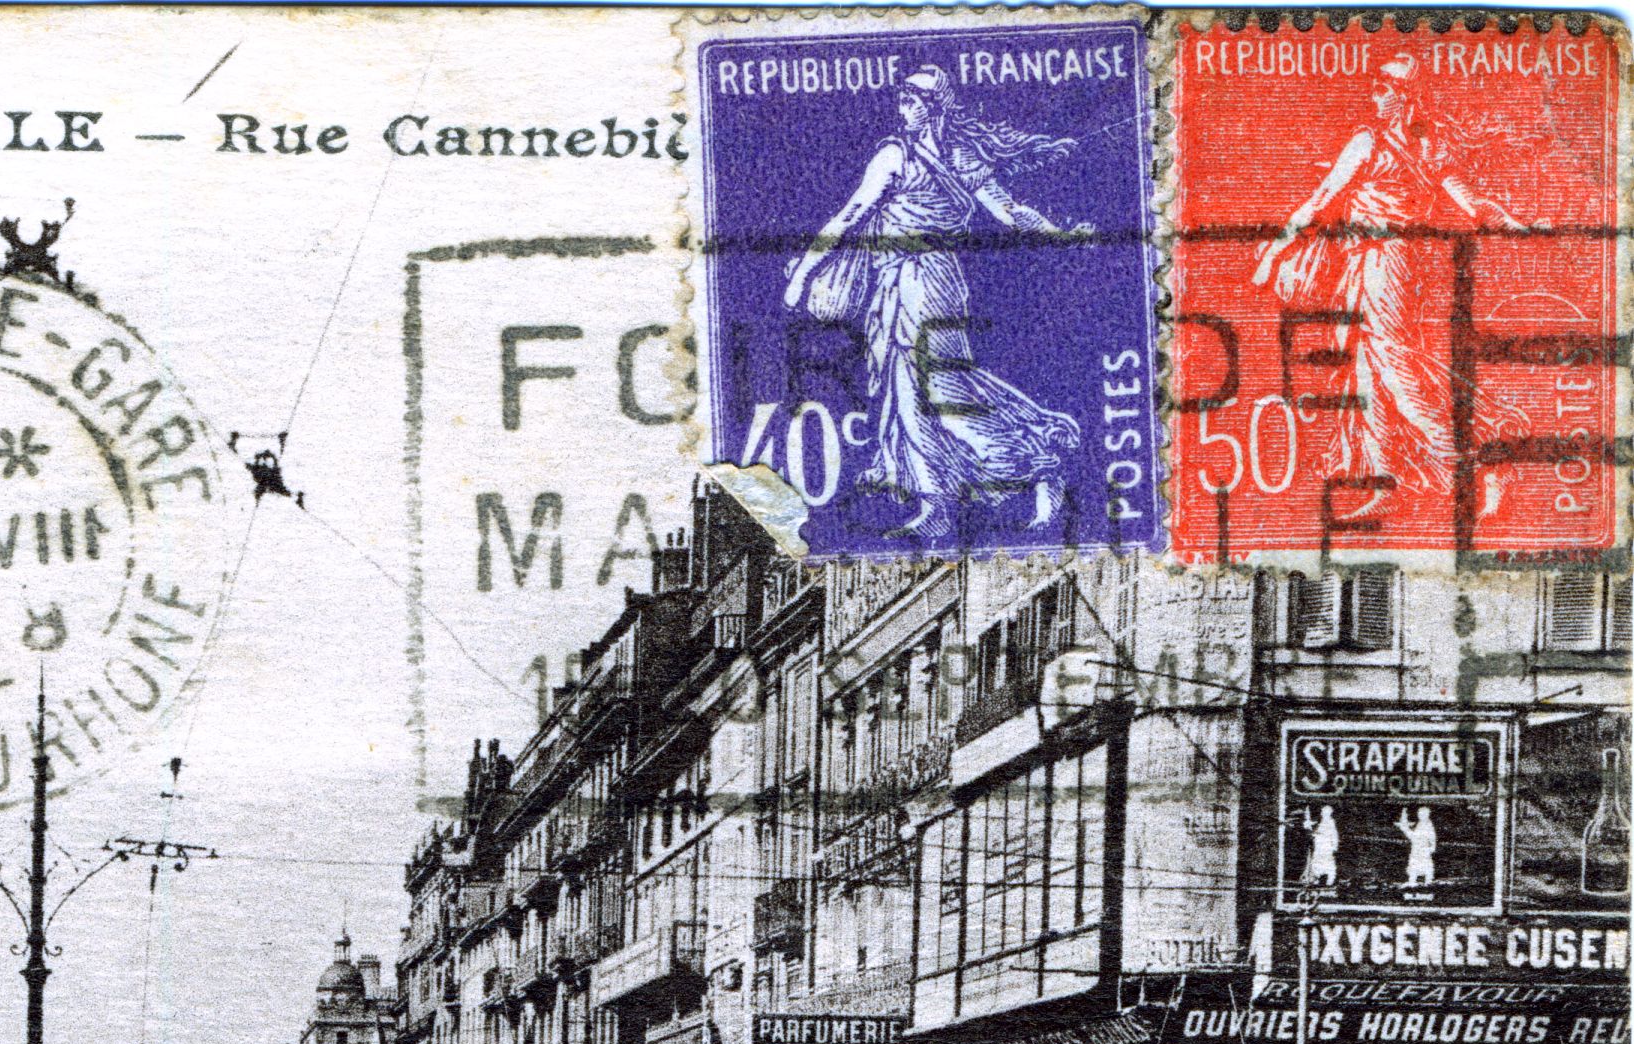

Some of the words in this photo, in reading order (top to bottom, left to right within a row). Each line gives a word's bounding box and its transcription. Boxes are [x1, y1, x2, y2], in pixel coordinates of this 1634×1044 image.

[959, 44, 1128, 87] FRANÇAISE
[1433, 41, 1598, 80] FRANÇAISE
[1102, 348, 1144, 520] POSTES
[1554, 346, 1594, 513] POSTES
[1359, 1011, 1549, 1043] HORLOGERS
